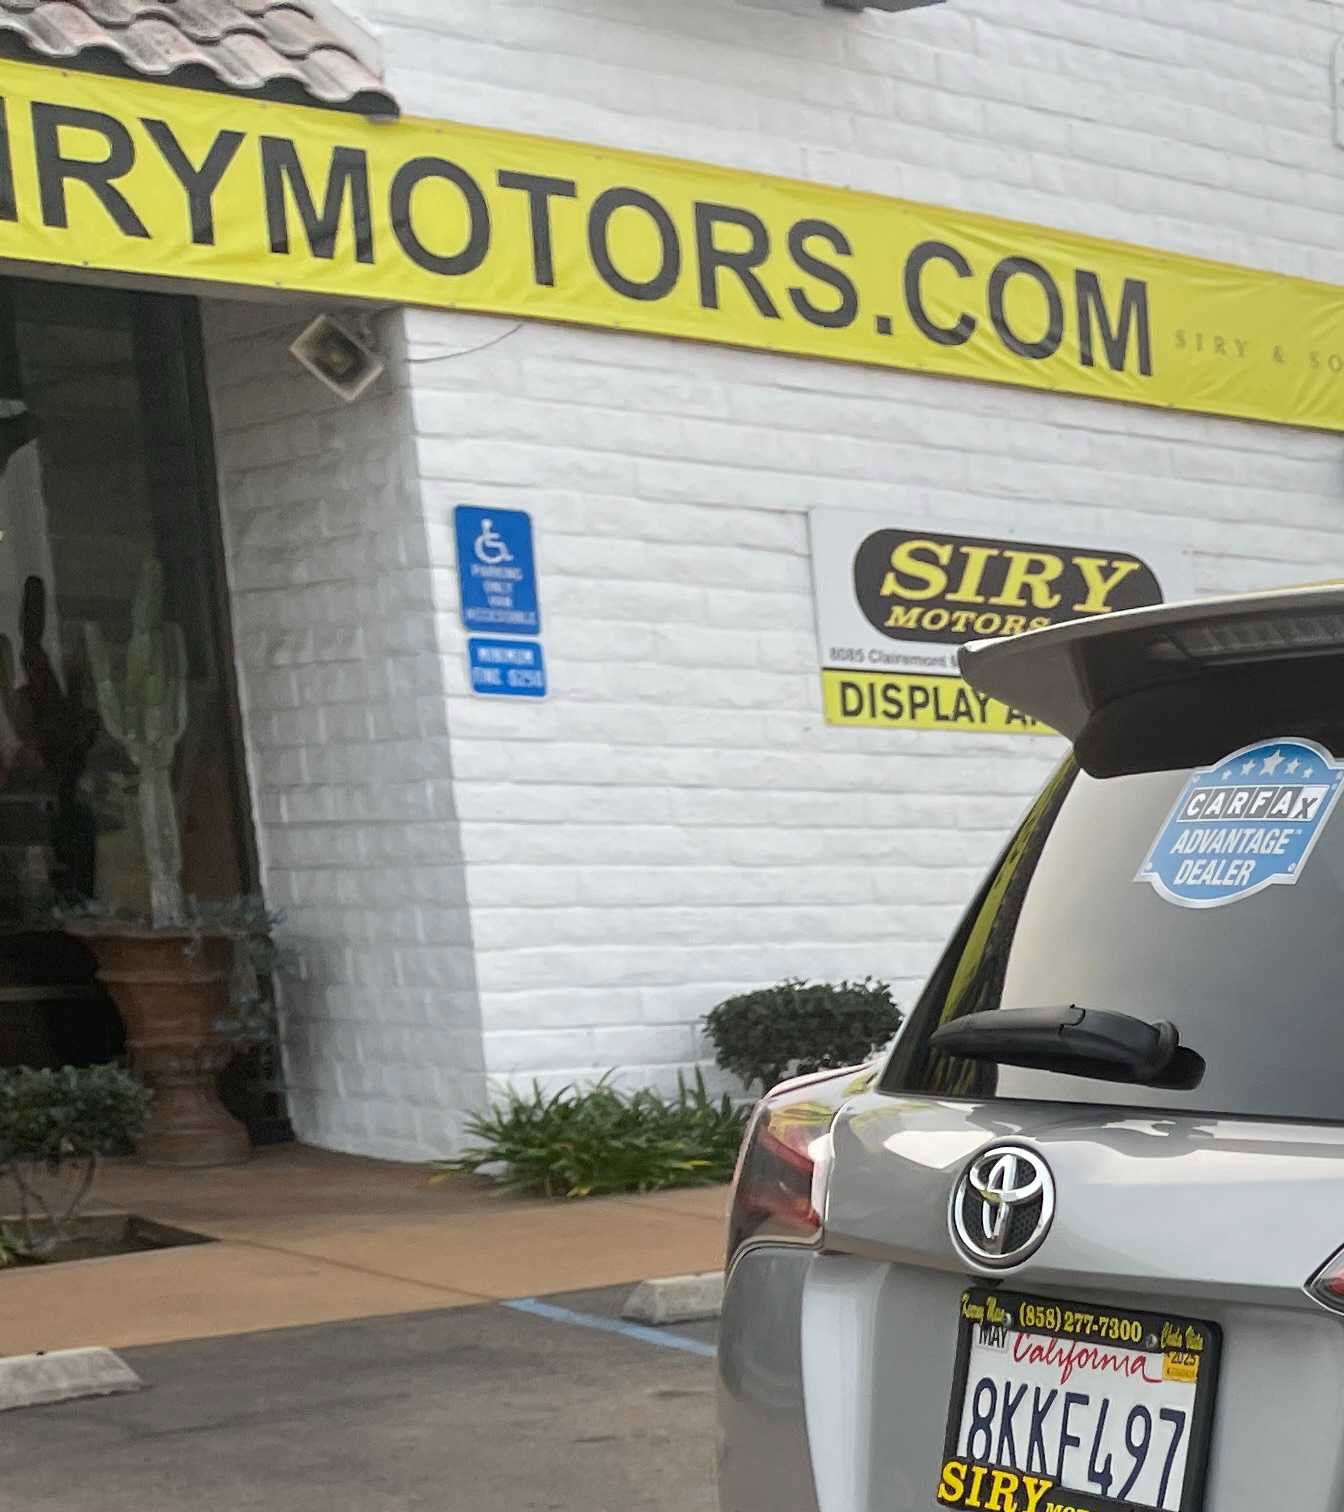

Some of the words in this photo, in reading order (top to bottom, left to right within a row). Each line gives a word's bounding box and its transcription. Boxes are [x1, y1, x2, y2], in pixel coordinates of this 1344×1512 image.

[1174, 329, 1248, 359] SIRY
[1271, 345, 1286, 365] &
[879, 538, 1141, 613] SIRY
[884, 605, 1051, 637] MOTORS
[839, 681, 990, 724] DISPLAY
[1186, 788, 1319, 820] CARFAX
[1169, 828, 1294, 855] ADVANTAGE
[1173, 859, 1256, 886] DEALER
[1012, 1332, 1163, 1385] California
[966, 1377, 1186, 1511] 8KKF497
